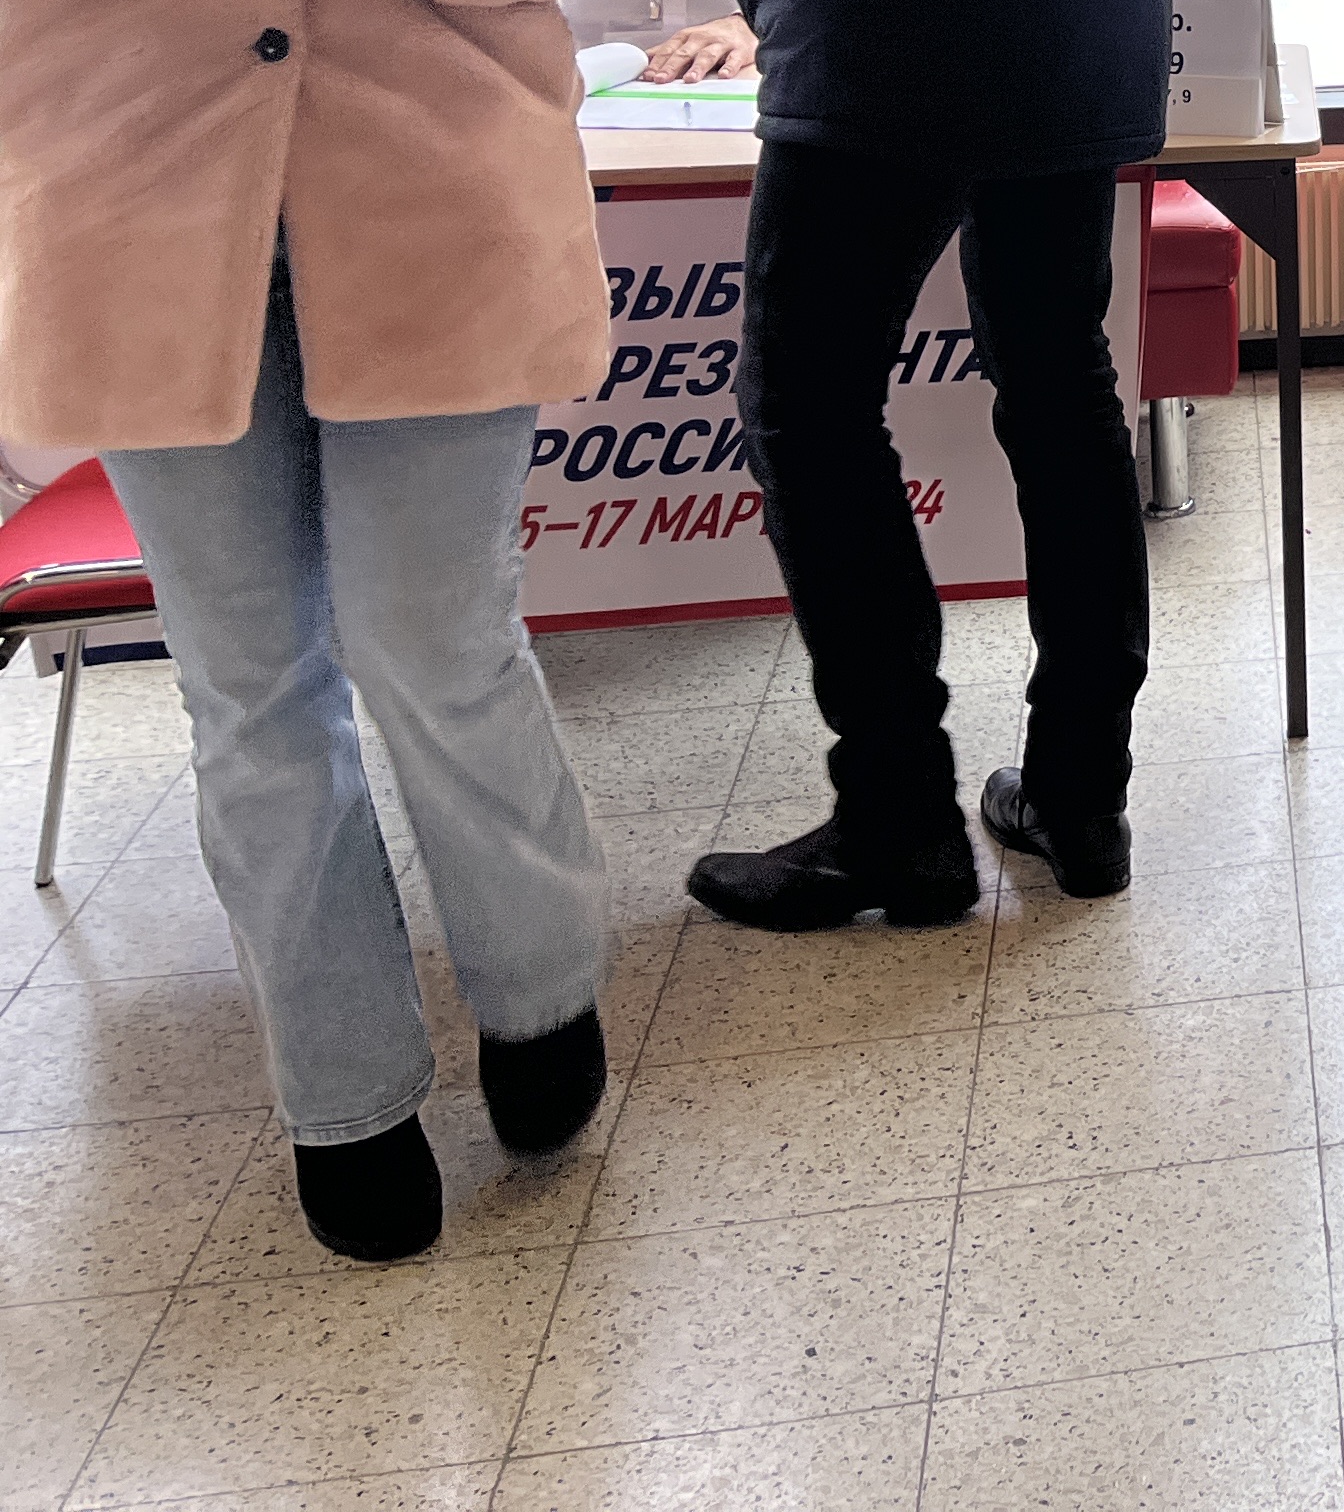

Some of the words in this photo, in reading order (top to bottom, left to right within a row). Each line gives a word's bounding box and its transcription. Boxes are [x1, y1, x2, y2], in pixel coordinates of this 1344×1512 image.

[605, 261, 746, 322] ВЫБ
[531, 418, 747, 482] РОССИ
[639, 491, 768, 545] МАР
